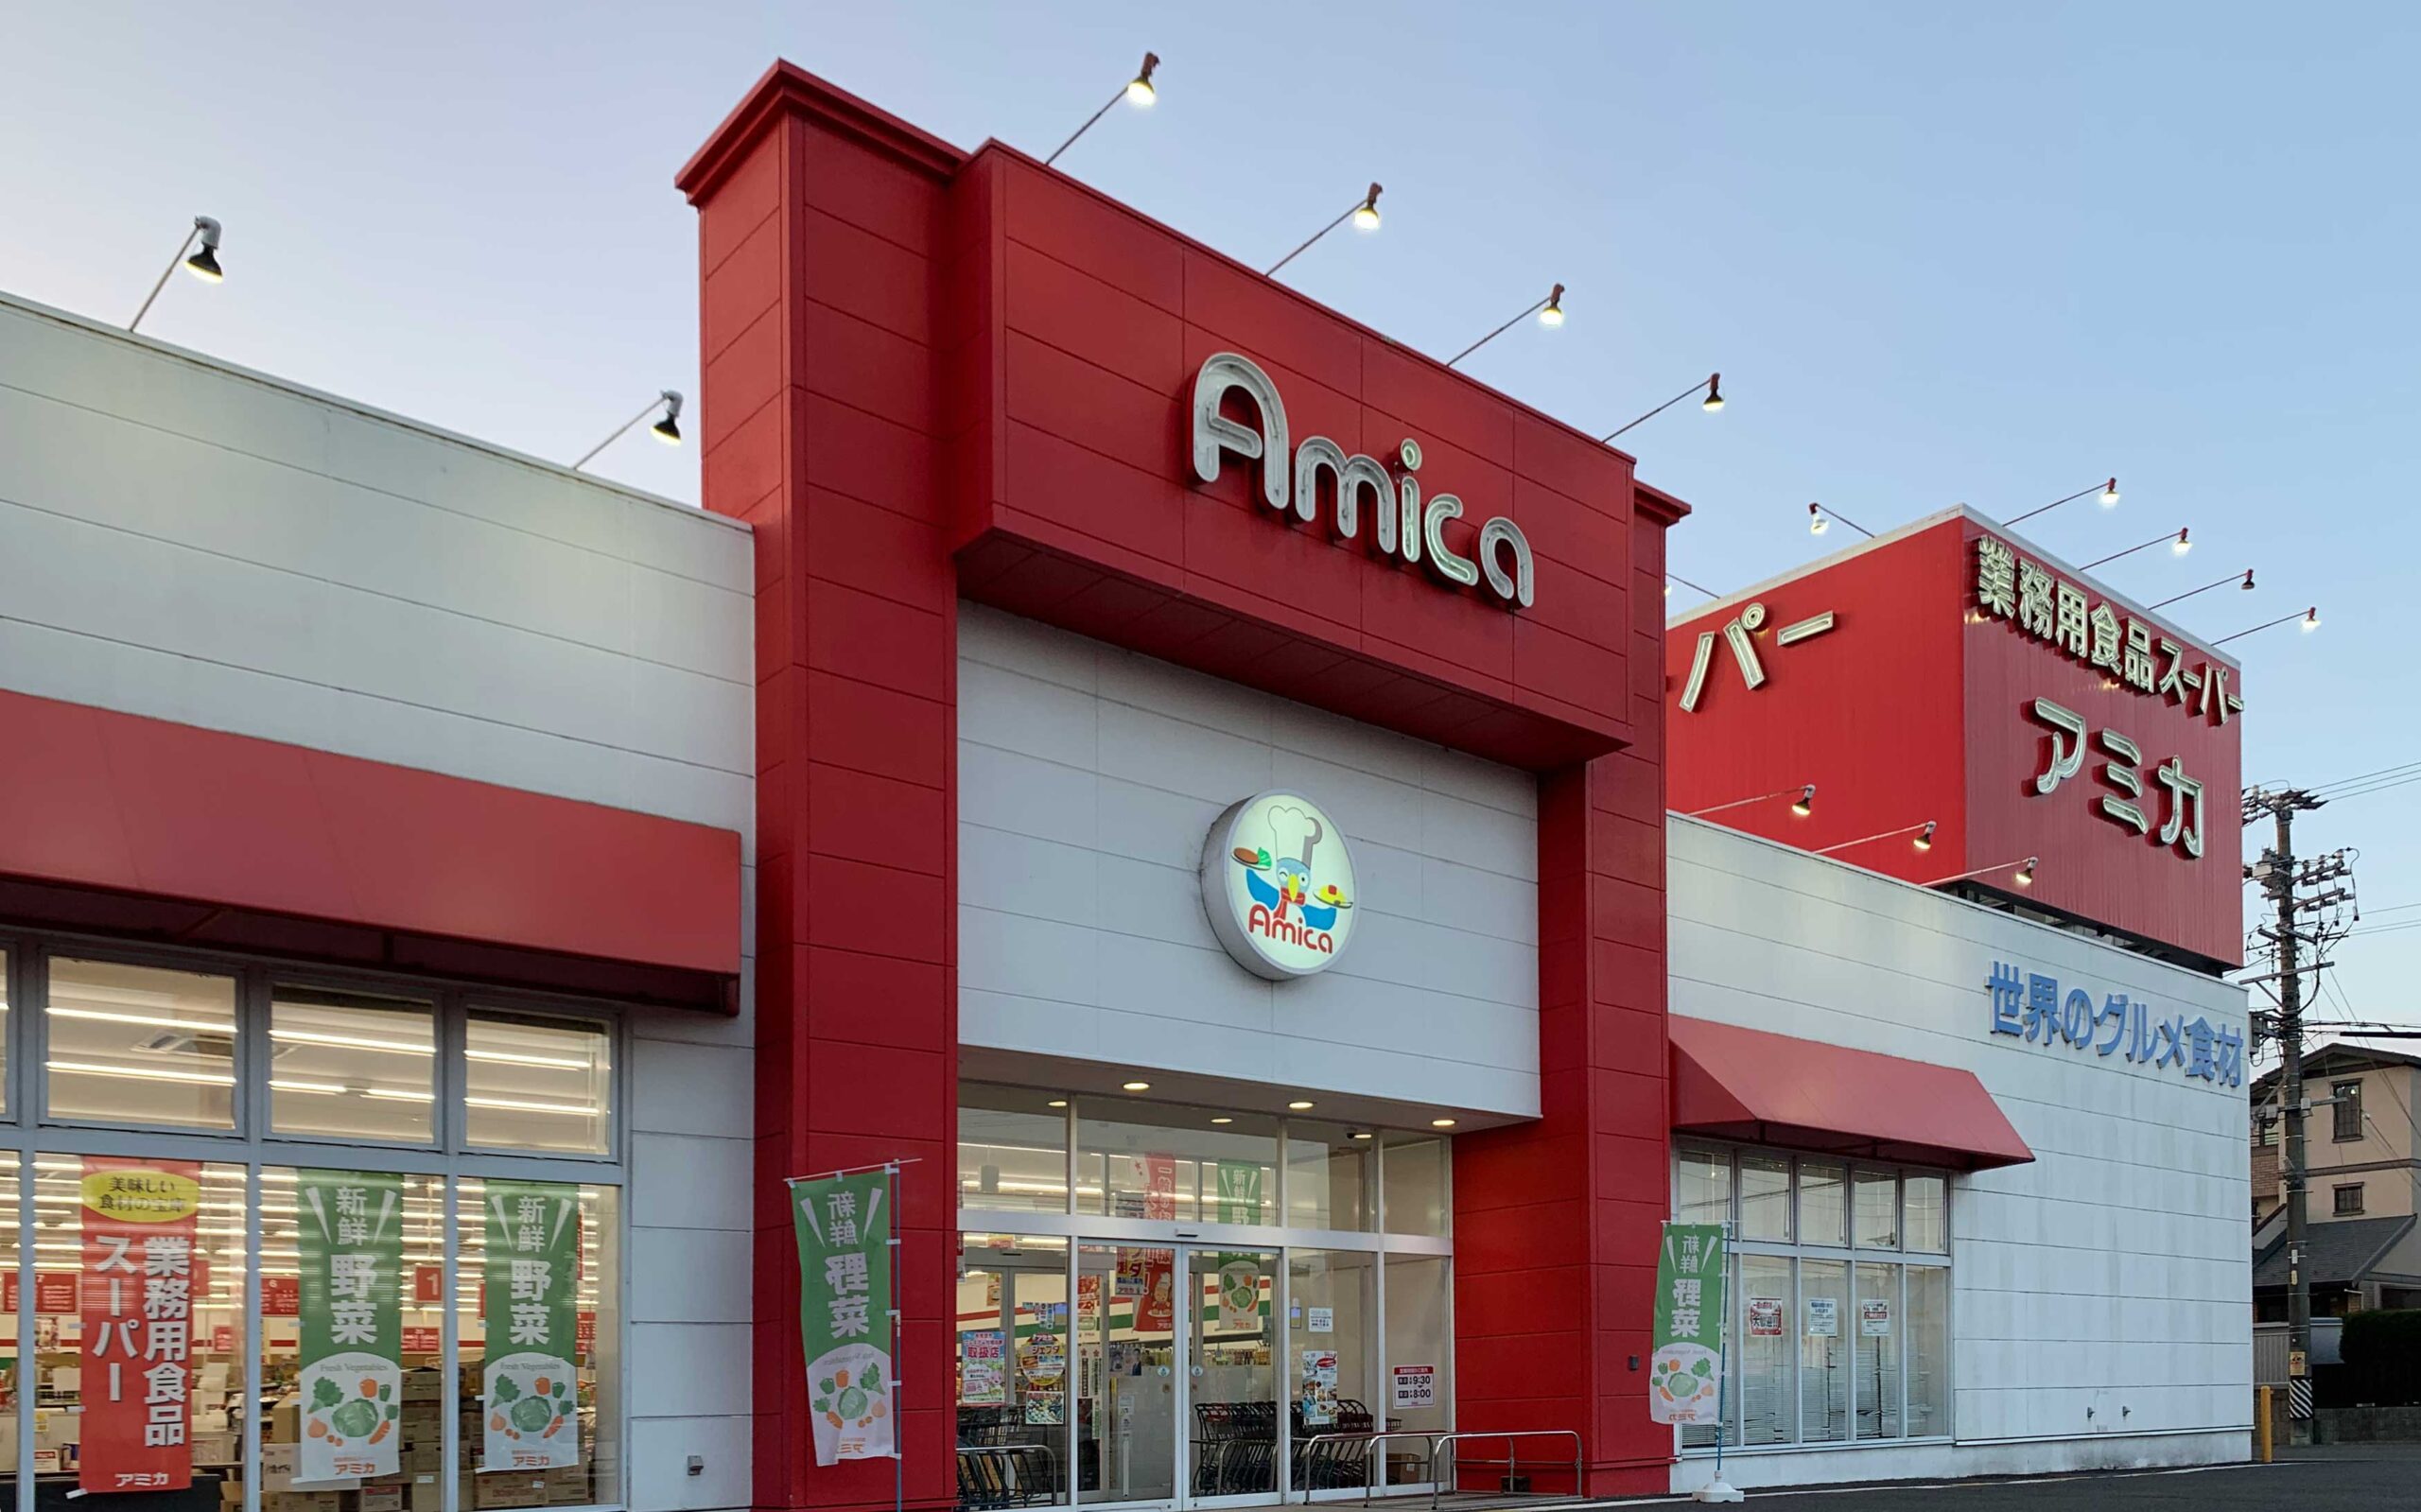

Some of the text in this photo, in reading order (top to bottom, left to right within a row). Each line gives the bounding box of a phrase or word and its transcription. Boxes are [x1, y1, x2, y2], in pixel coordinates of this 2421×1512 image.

[1193, 351, 1536, 608] Amica
[1679, 601, 1834, 714] パー
[1977, 534, 2245, 725] 業務用食品スーパー
[2035, 697, 2204, 858] アミカ
[1248, 903, 1333, 955] Amica
[1984, 960, 2244, 1088] 世界のグルメ食材
[98, 1193, 186, 1213] 食材の宝庫
[109, 1176, 176, 1193] 美味しい
[92, 1235, 139, 1401] スーパー
[142, 1236, 191, 1448] 業務用食品
[967, 1347, 1000, 1359] 取扱店
[114, 1471, 169, 1487] アミカ
[335, 1462, 376, 1475] アミカ
[513, 1454, 550, 1467] アミカ
